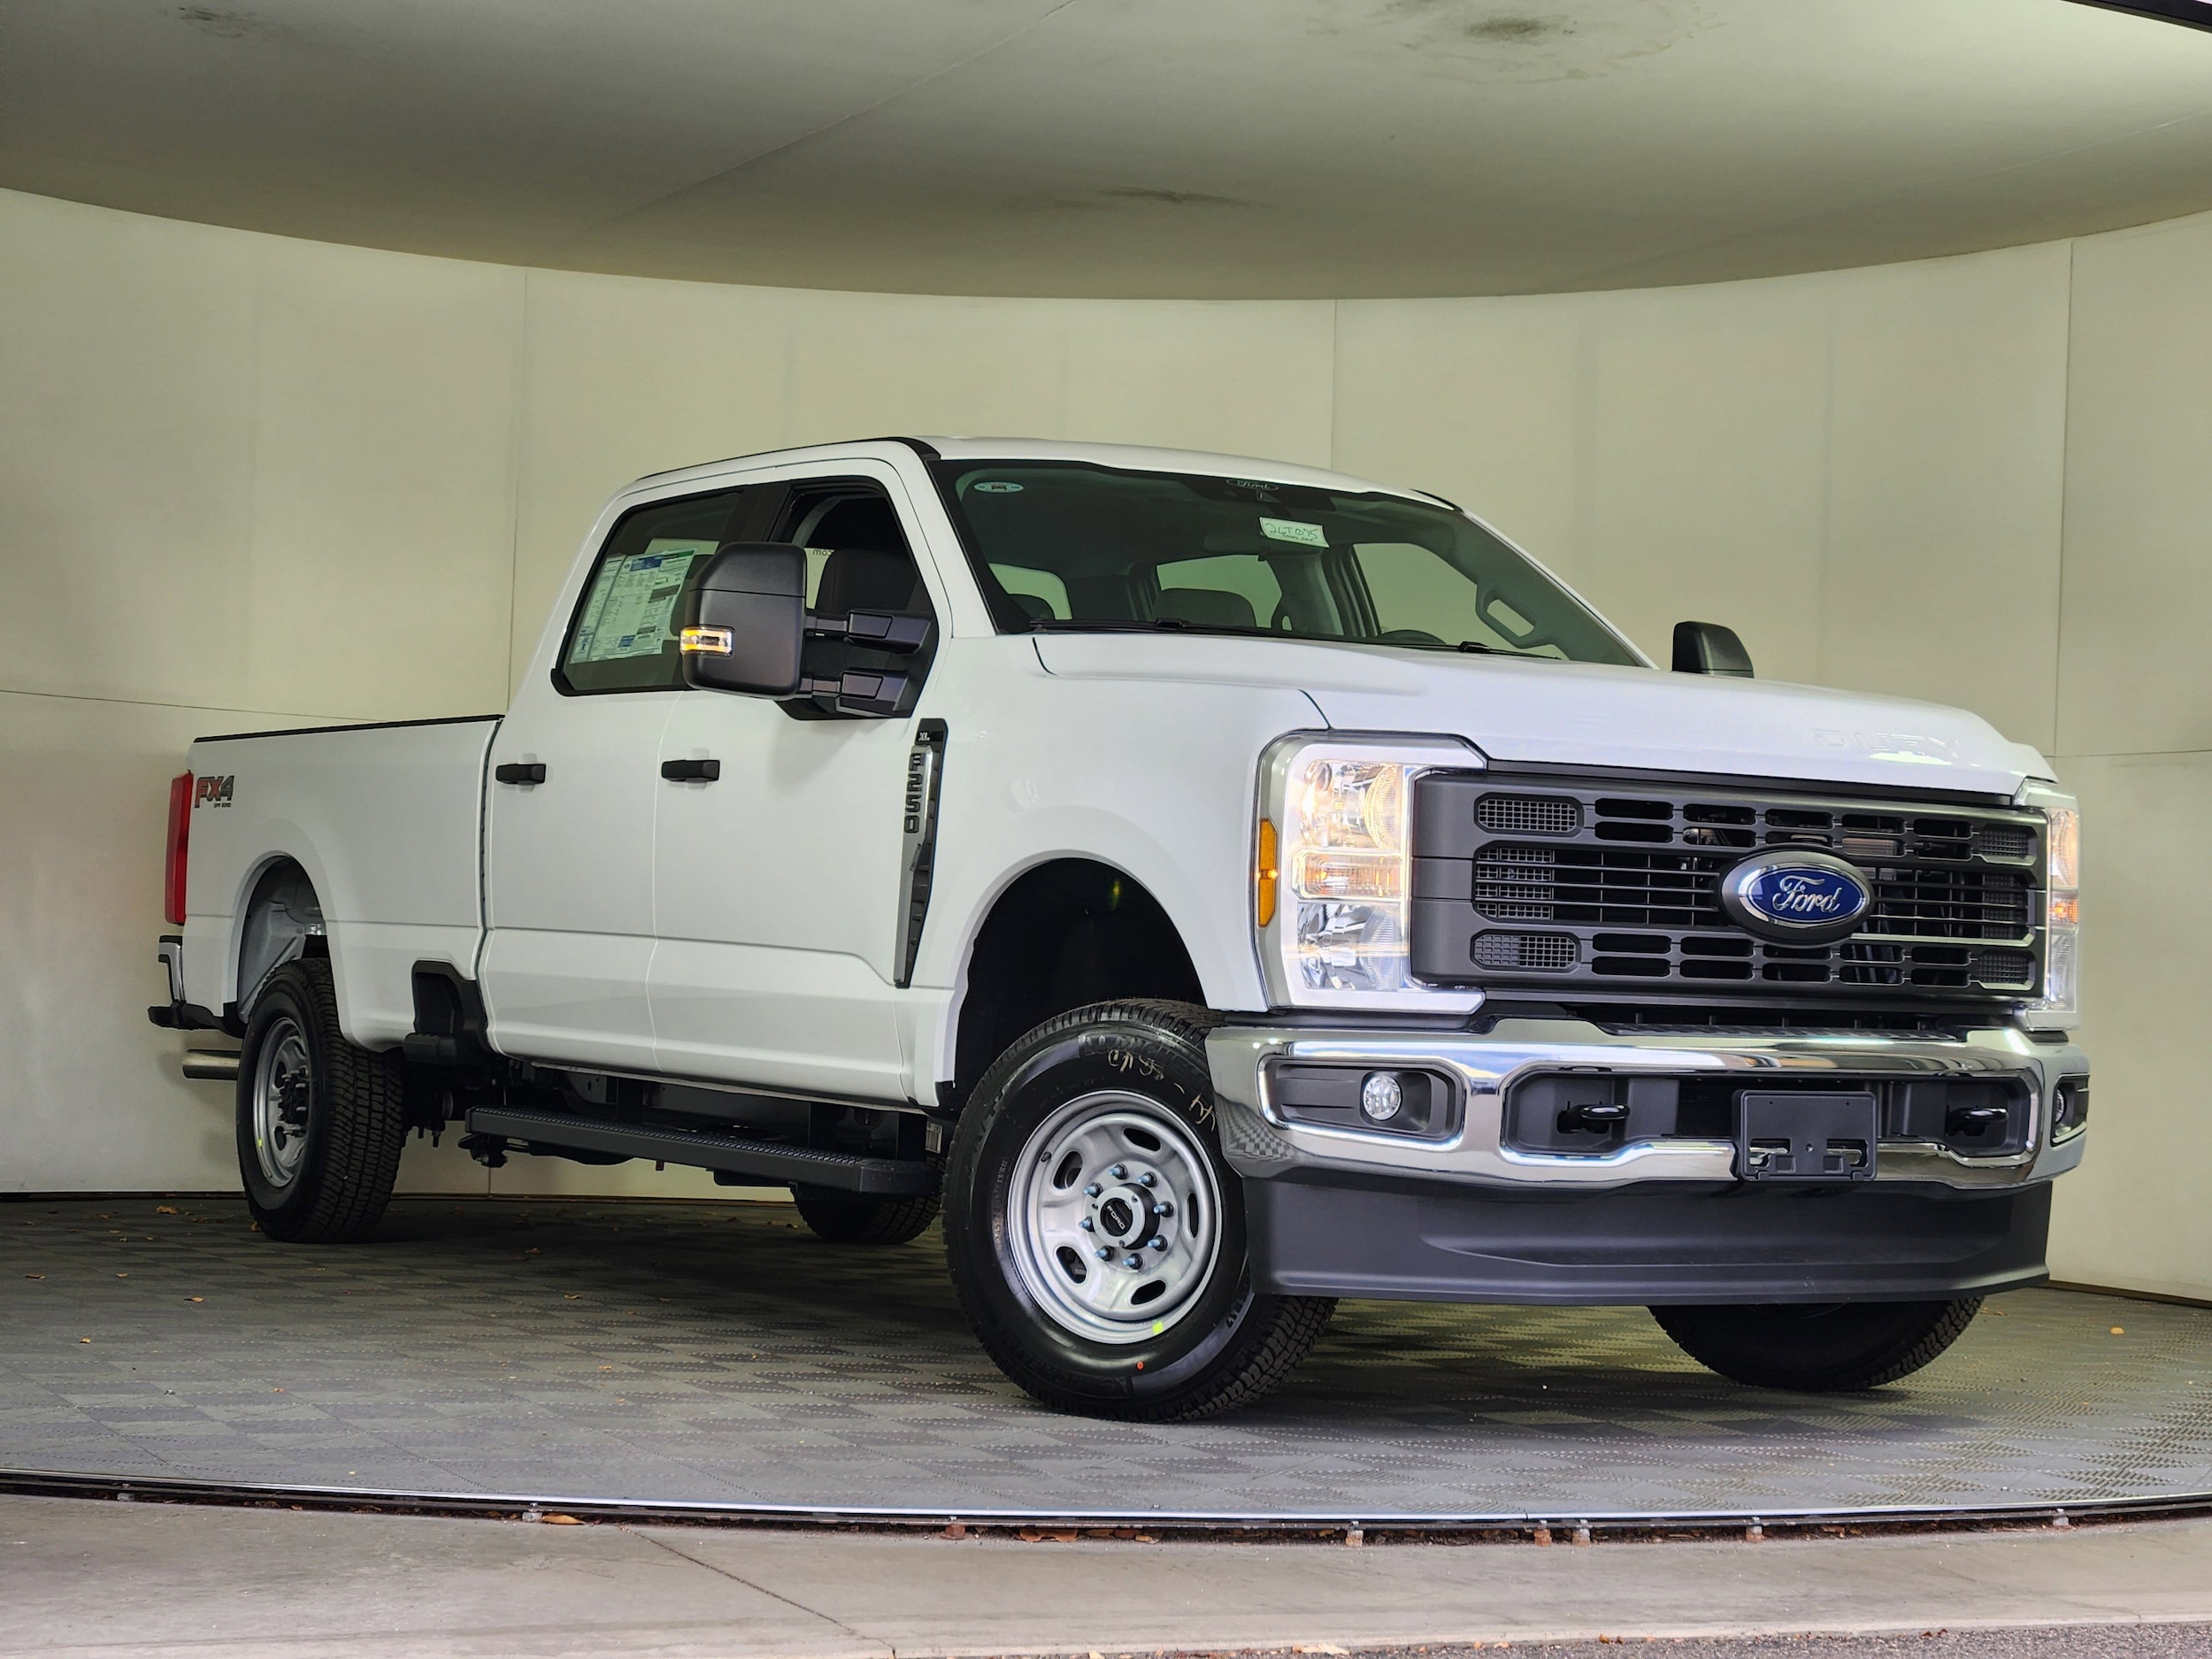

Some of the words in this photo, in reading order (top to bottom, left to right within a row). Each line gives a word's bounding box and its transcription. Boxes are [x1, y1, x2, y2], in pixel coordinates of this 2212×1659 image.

[918, 732, 931, 741] XL
[194, 775, 234, 809] FX4
[903, 753, 924, 833] F250
[1771, 874, 1843, 913] Ford
[1106, 1204, 1125, 1230] FORD
